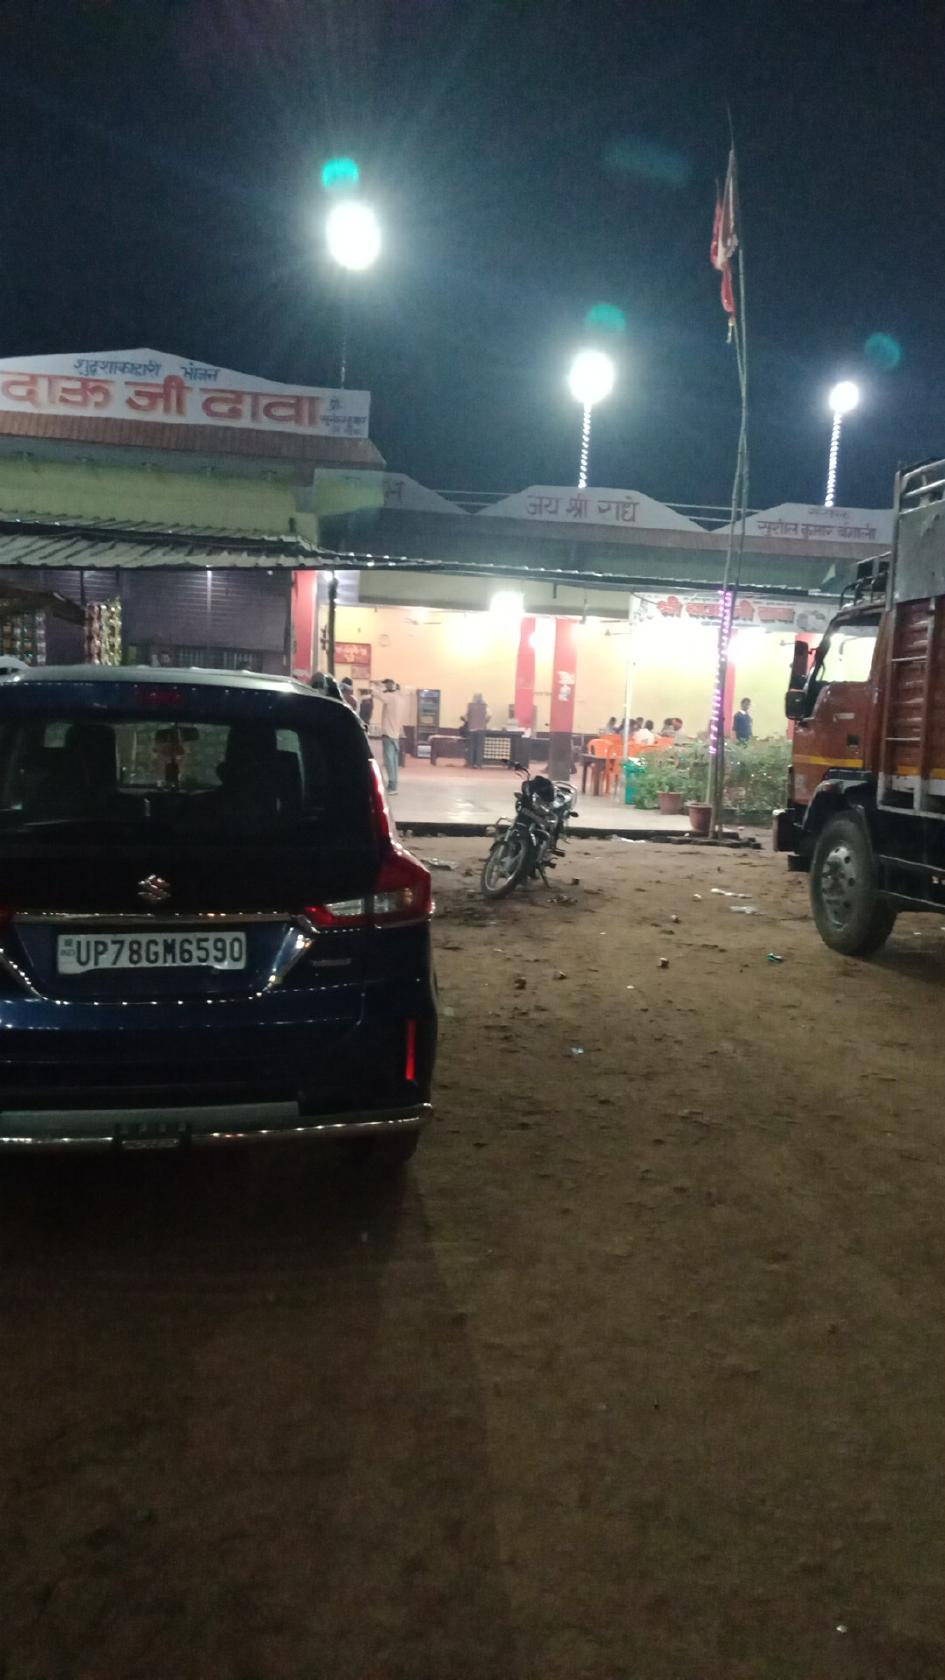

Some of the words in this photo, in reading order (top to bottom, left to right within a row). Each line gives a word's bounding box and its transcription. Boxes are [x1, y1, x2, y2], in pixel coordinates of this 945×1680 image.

[125, 375, 193, 416] जी
[527, 495, 562, 515] जय
[565, 492, 591, 519] श्री
[76, 937, 243, 966] UP78GM6590
